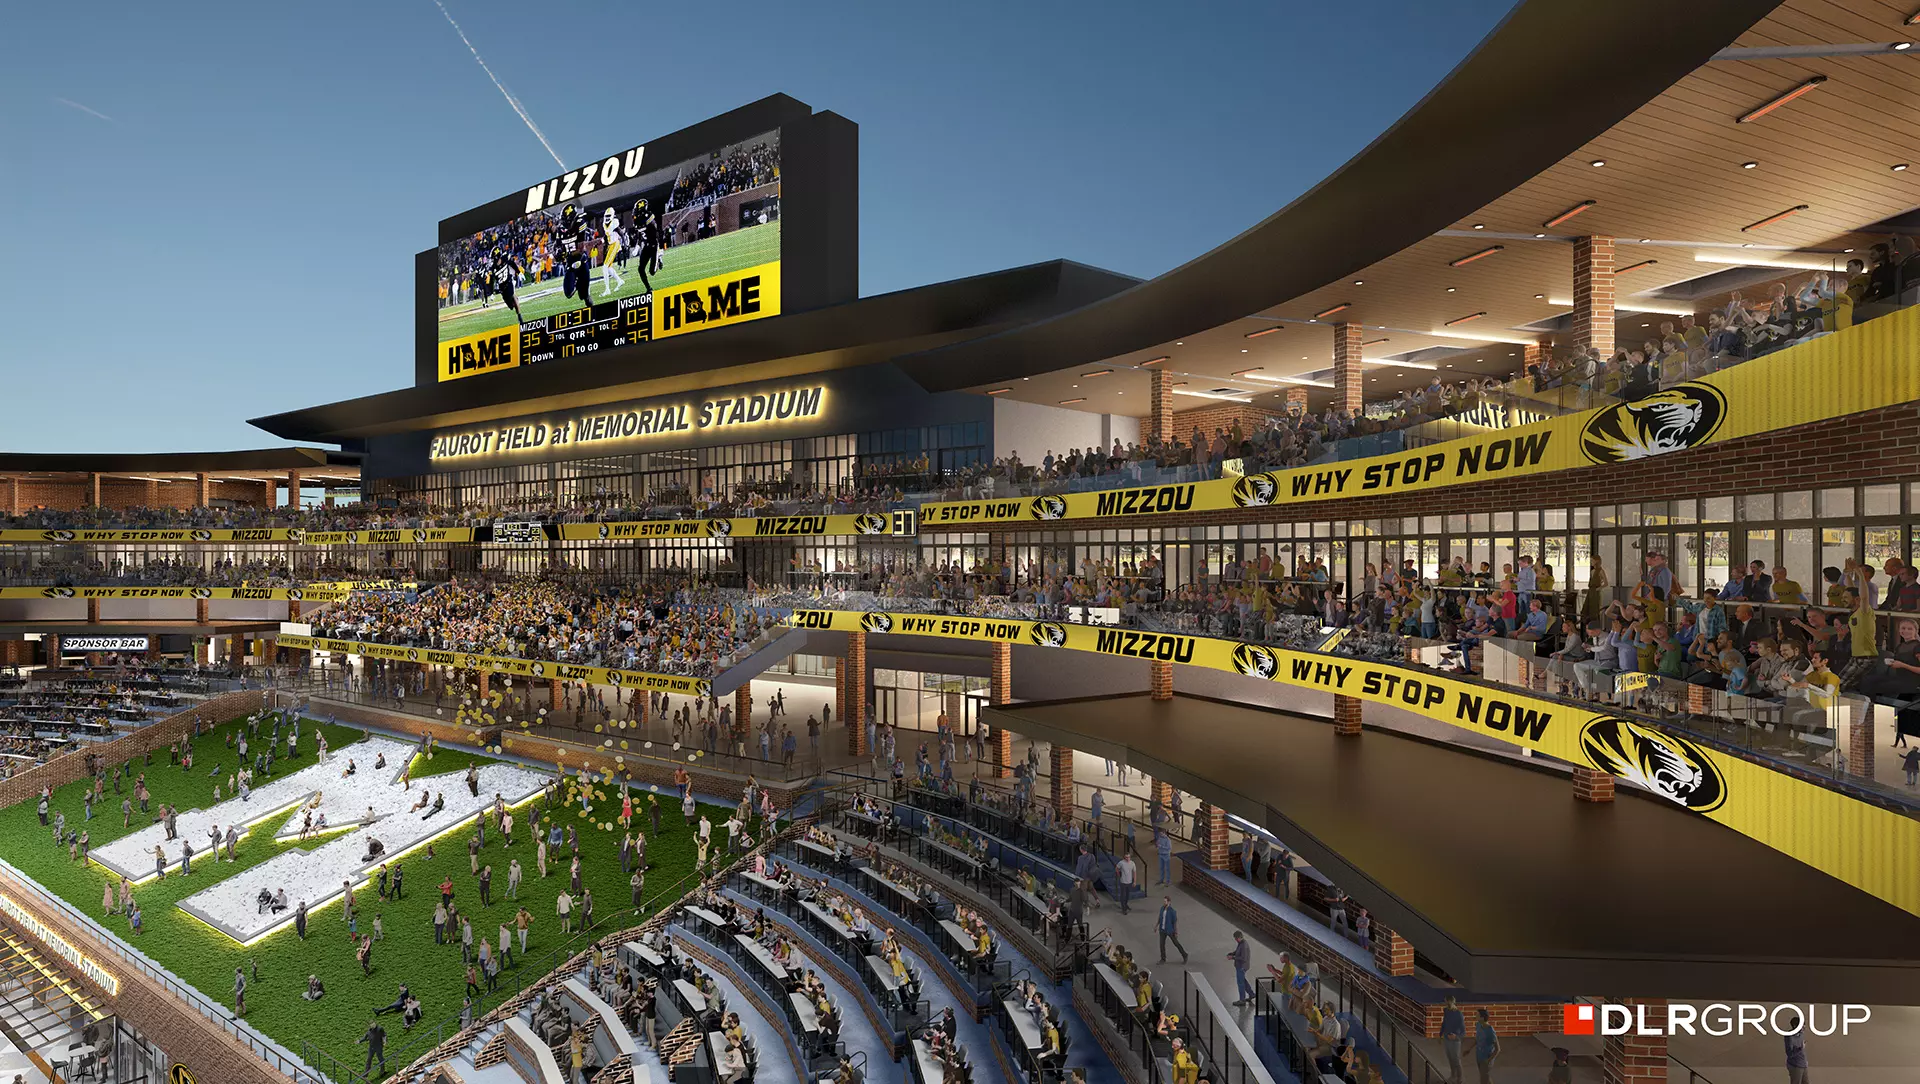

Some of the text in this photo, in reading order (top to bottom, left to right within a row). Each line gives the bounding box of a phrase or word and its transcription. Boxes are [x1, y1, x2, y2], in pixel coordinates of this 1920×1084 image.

[525, 146, 645, 213] MIZZOU
[620, 294, 652, 309] VISITOR
[627, 307, 648, 326] 03
[520, 319, 546, 332] MIZZOU
[555, 333, 565, 341] TOL
[570, 330, 585, 340] QTR
[599, 323, 609, 331] TOL
[523, 331, 540, 348] 35
[532, 351, 554, 363] DOWN
[576, 345, 585, 354] TO
[587, 342, 598, 352] GO
[614, 337, 625, 346] ON
[430, 387, 823, 459] FAUROT FIELD at MEMORIAL STADIUM
[1291, 430, 1552, 497] WHY STOP NOW
[1096, 485, 1196, 516] MIZZOU
[941, 505, 980, 520] STOP
[985, 503, 1021, 518] NOW
[614, 523, 699, 536] WHY STOP NOW
[755, 516, 827, 535] MIZZOU
[893, 510, 914, 535] 37
[232, 529, 272, 540] MIZZOU
[314, 534, 328, 542] STOP
[330, 534, 342, 542] NOW
[368, 531, 401, 542] MIZZOU
[430, 531, 446, 539] WHY
[84, 589, 184, 597] WHY STOP NOW
[232, 589, 272, 599] MIZZOU
[306, 591, 317, 599] WHY
[319, 592, 332, 600] STOP
[902, 618, 1021, 639] WHY STOP NOW
[63, 639, 144, 648] SPONSOR BAR
[327, 641, 349, 652] MIZZOU
[1096, 629, 1195, 663] MIZZOU
[379, 648, 392, 656] STOP
[393, 649, 405, 658] NOW
[427, 652, 454, 664] MIZZOU
[626, 675, 690, 690] WHY STOP NOW
[1290, 658, 1552, 743] WHY STOP NOW
[20, 911, 36, 934] FIELD
[36, 926, 45, 941] AT
[46, 932, 80, 968] MEMORIAL
[81, 958, 115, 996] STADIUM
